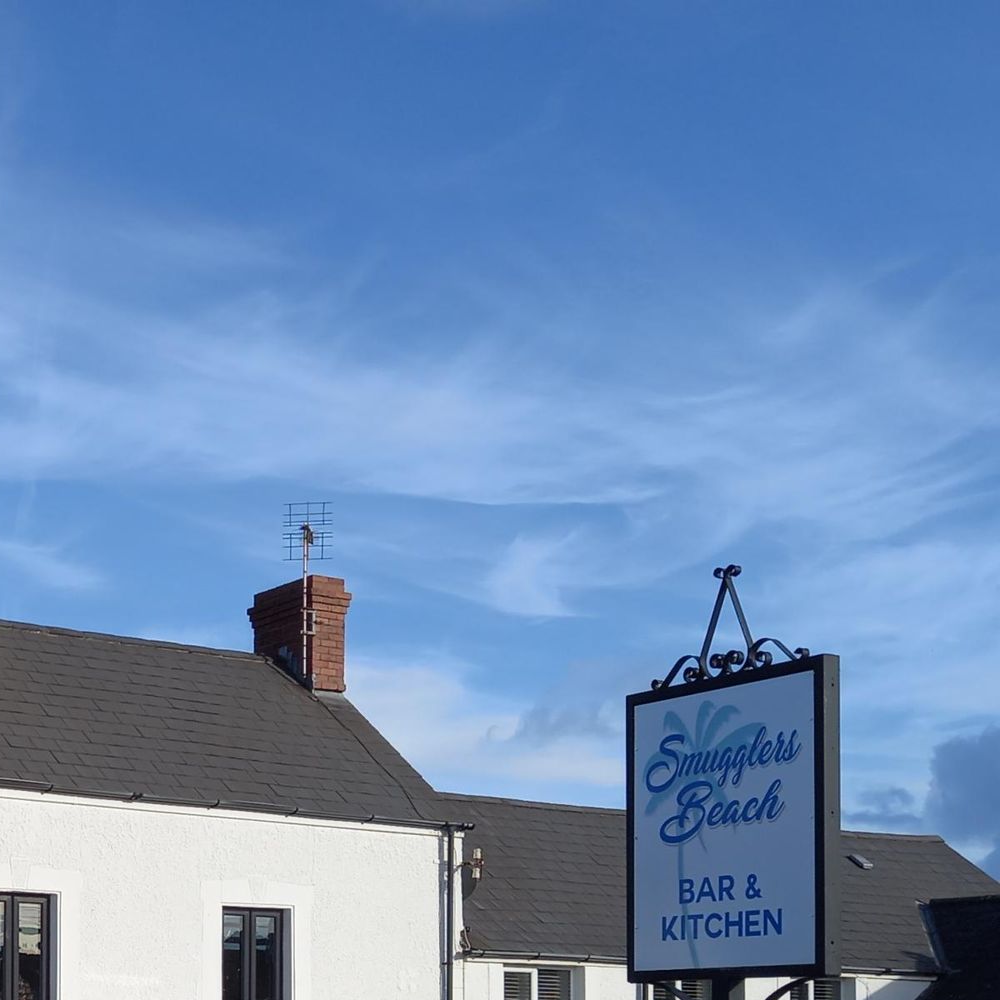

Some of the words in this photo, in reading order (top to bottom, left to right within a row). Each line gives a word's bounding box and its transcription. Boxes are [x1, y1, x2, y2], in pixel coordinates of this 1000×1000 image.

[646, 726, 801, 794] Smugglers
[660, 779, 784, 844] Beach
[679, 875, 735, 905] BAR
[745, 873, 763, 900] &
[661, 908, 783, 942] KITCHEN
